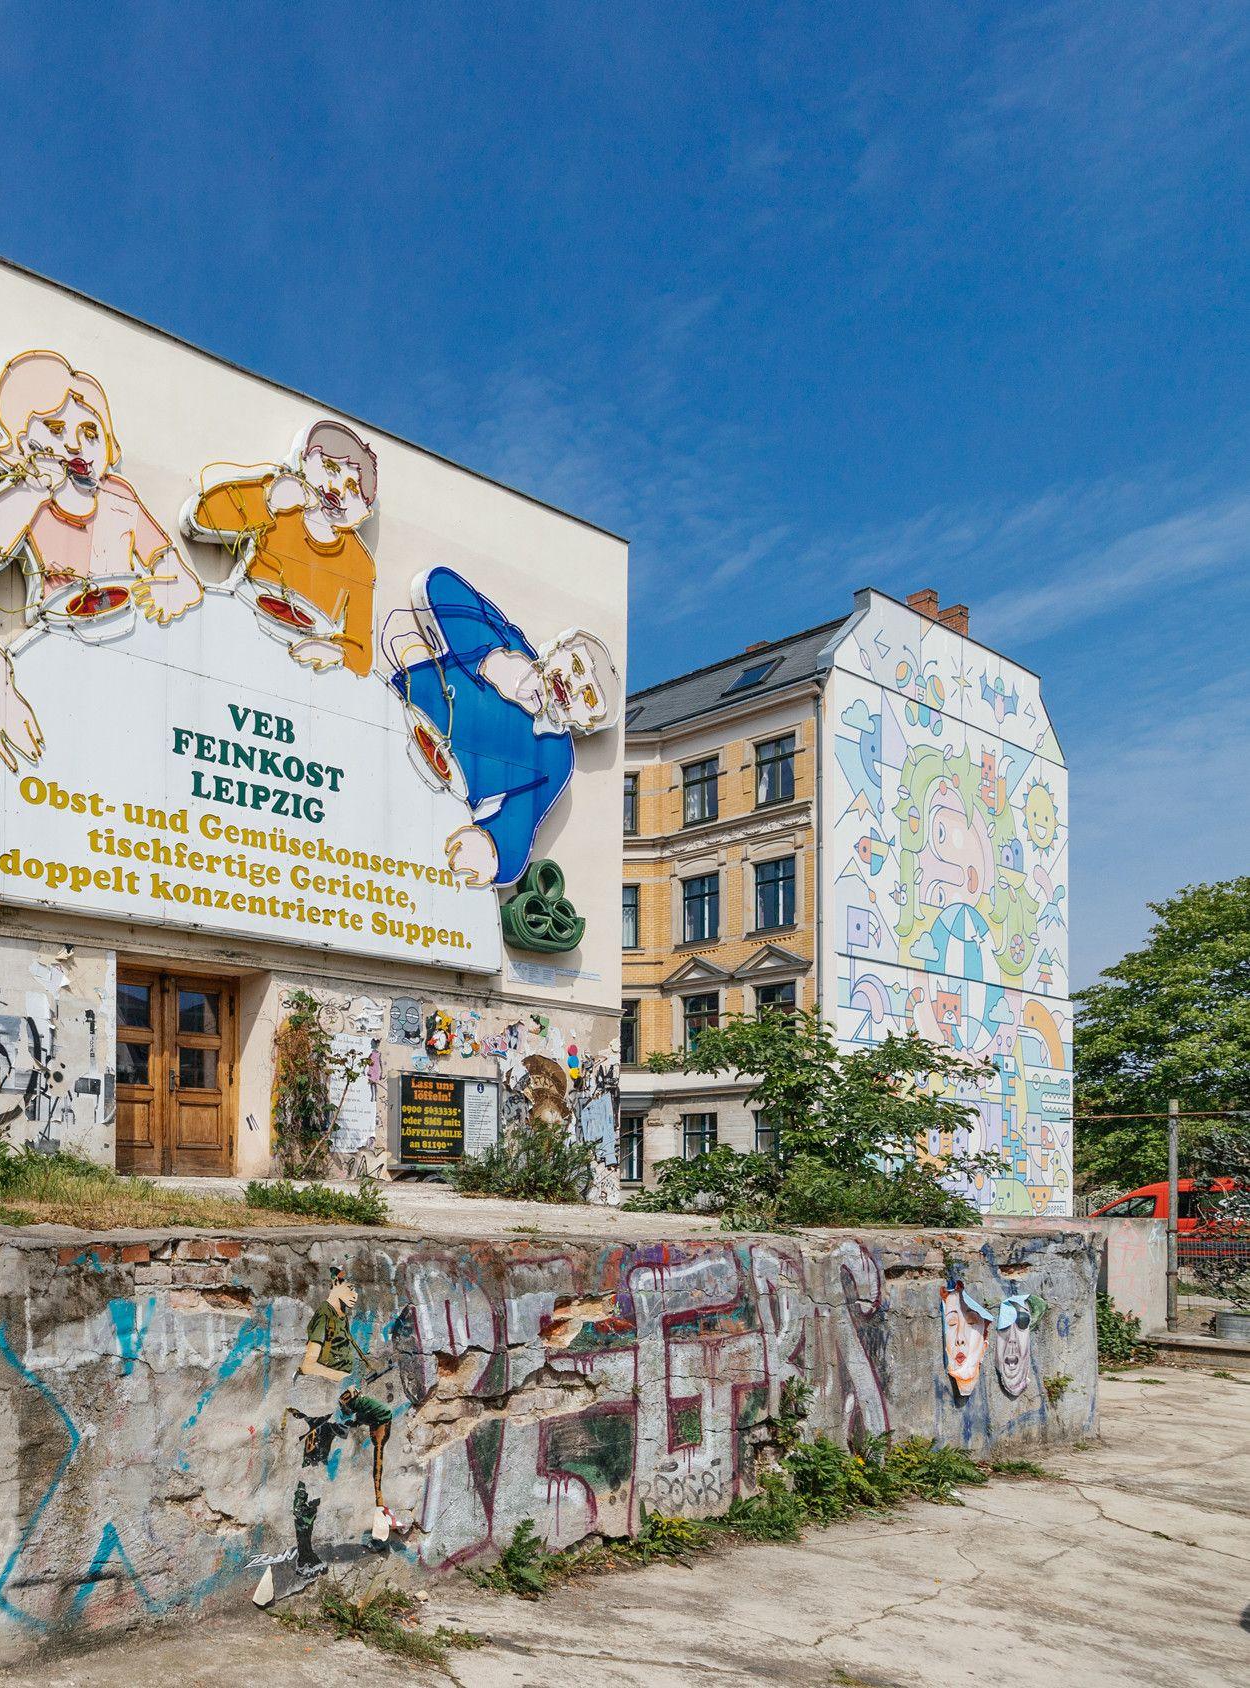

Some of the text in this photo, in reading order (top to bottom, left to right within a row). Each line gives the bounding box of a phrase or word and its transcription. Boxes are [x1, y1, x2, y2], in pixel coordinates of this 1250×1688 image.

[229, 703, 295, 744] VEB
[172, 727, 345, 793] FEINKOST
[191, 770, 326, 824] LEIPZIG
[19, 776, 463, 891] Obst- und Gemüsekonserven,
[87, 828, 416, 912] tischfertige Gerichte,
[150, 873, 364, 931] konzentrierte
[371, 911, 472, 950] Suppen.
[411, 1078, 455, 1091] Lass uns
[413, 1090, 452, 1102] löffeln!
[401, 1105, 422, 1114] 0900
[402, 1116, 461, 1127] oder SMS mit:
[401, 1126, 463, 1139] LÖFFELFAMILIE
[409, 1140, 420, 1149] an
